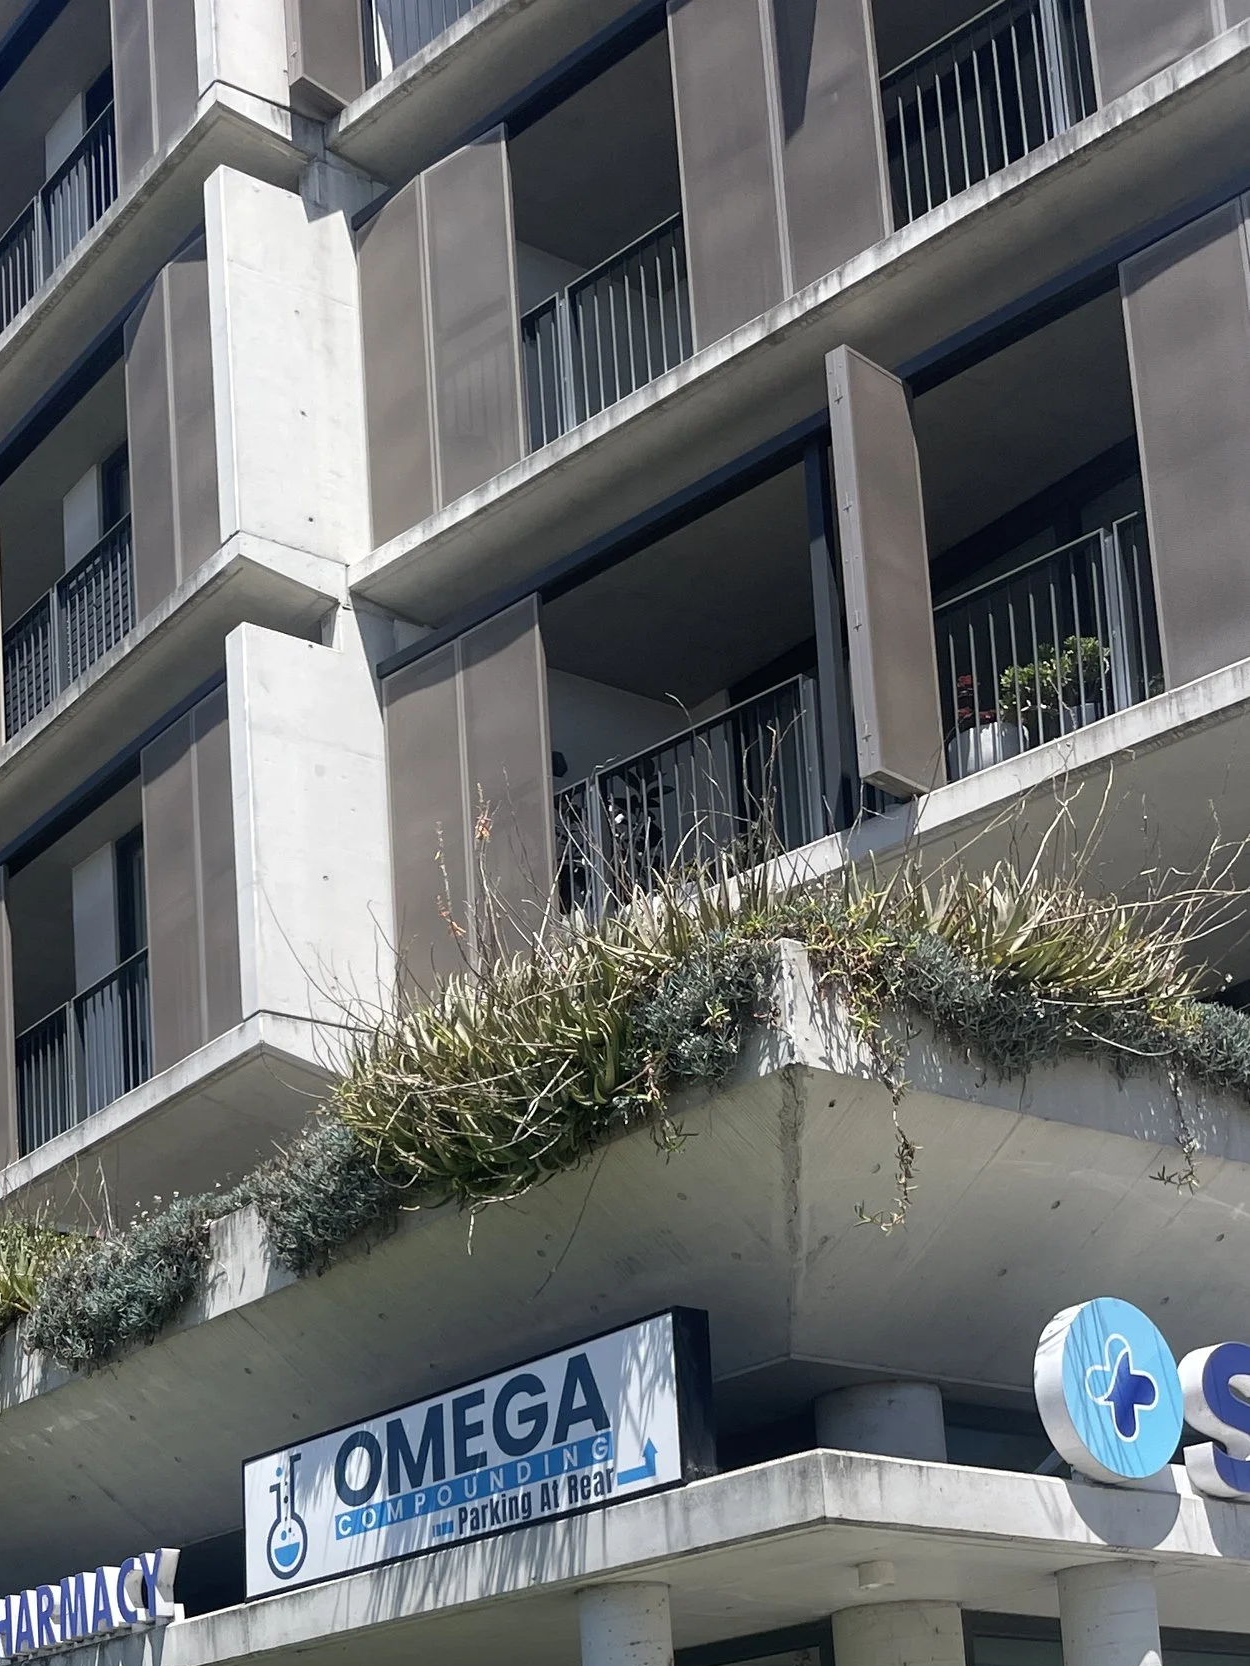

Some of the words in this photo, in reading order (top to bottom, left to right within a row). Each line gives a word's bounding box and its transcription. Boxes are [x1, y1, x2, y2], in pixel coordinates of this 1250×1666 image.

[334, 1353, 611, 1507] OMEGA
[338, 1436, 610, 1537] COMPOUNDING
[458, 1493, 532, 1535] Parking
[540, 1480, 559, 1513] At
[569, 1467, 615, 1504] Rear
